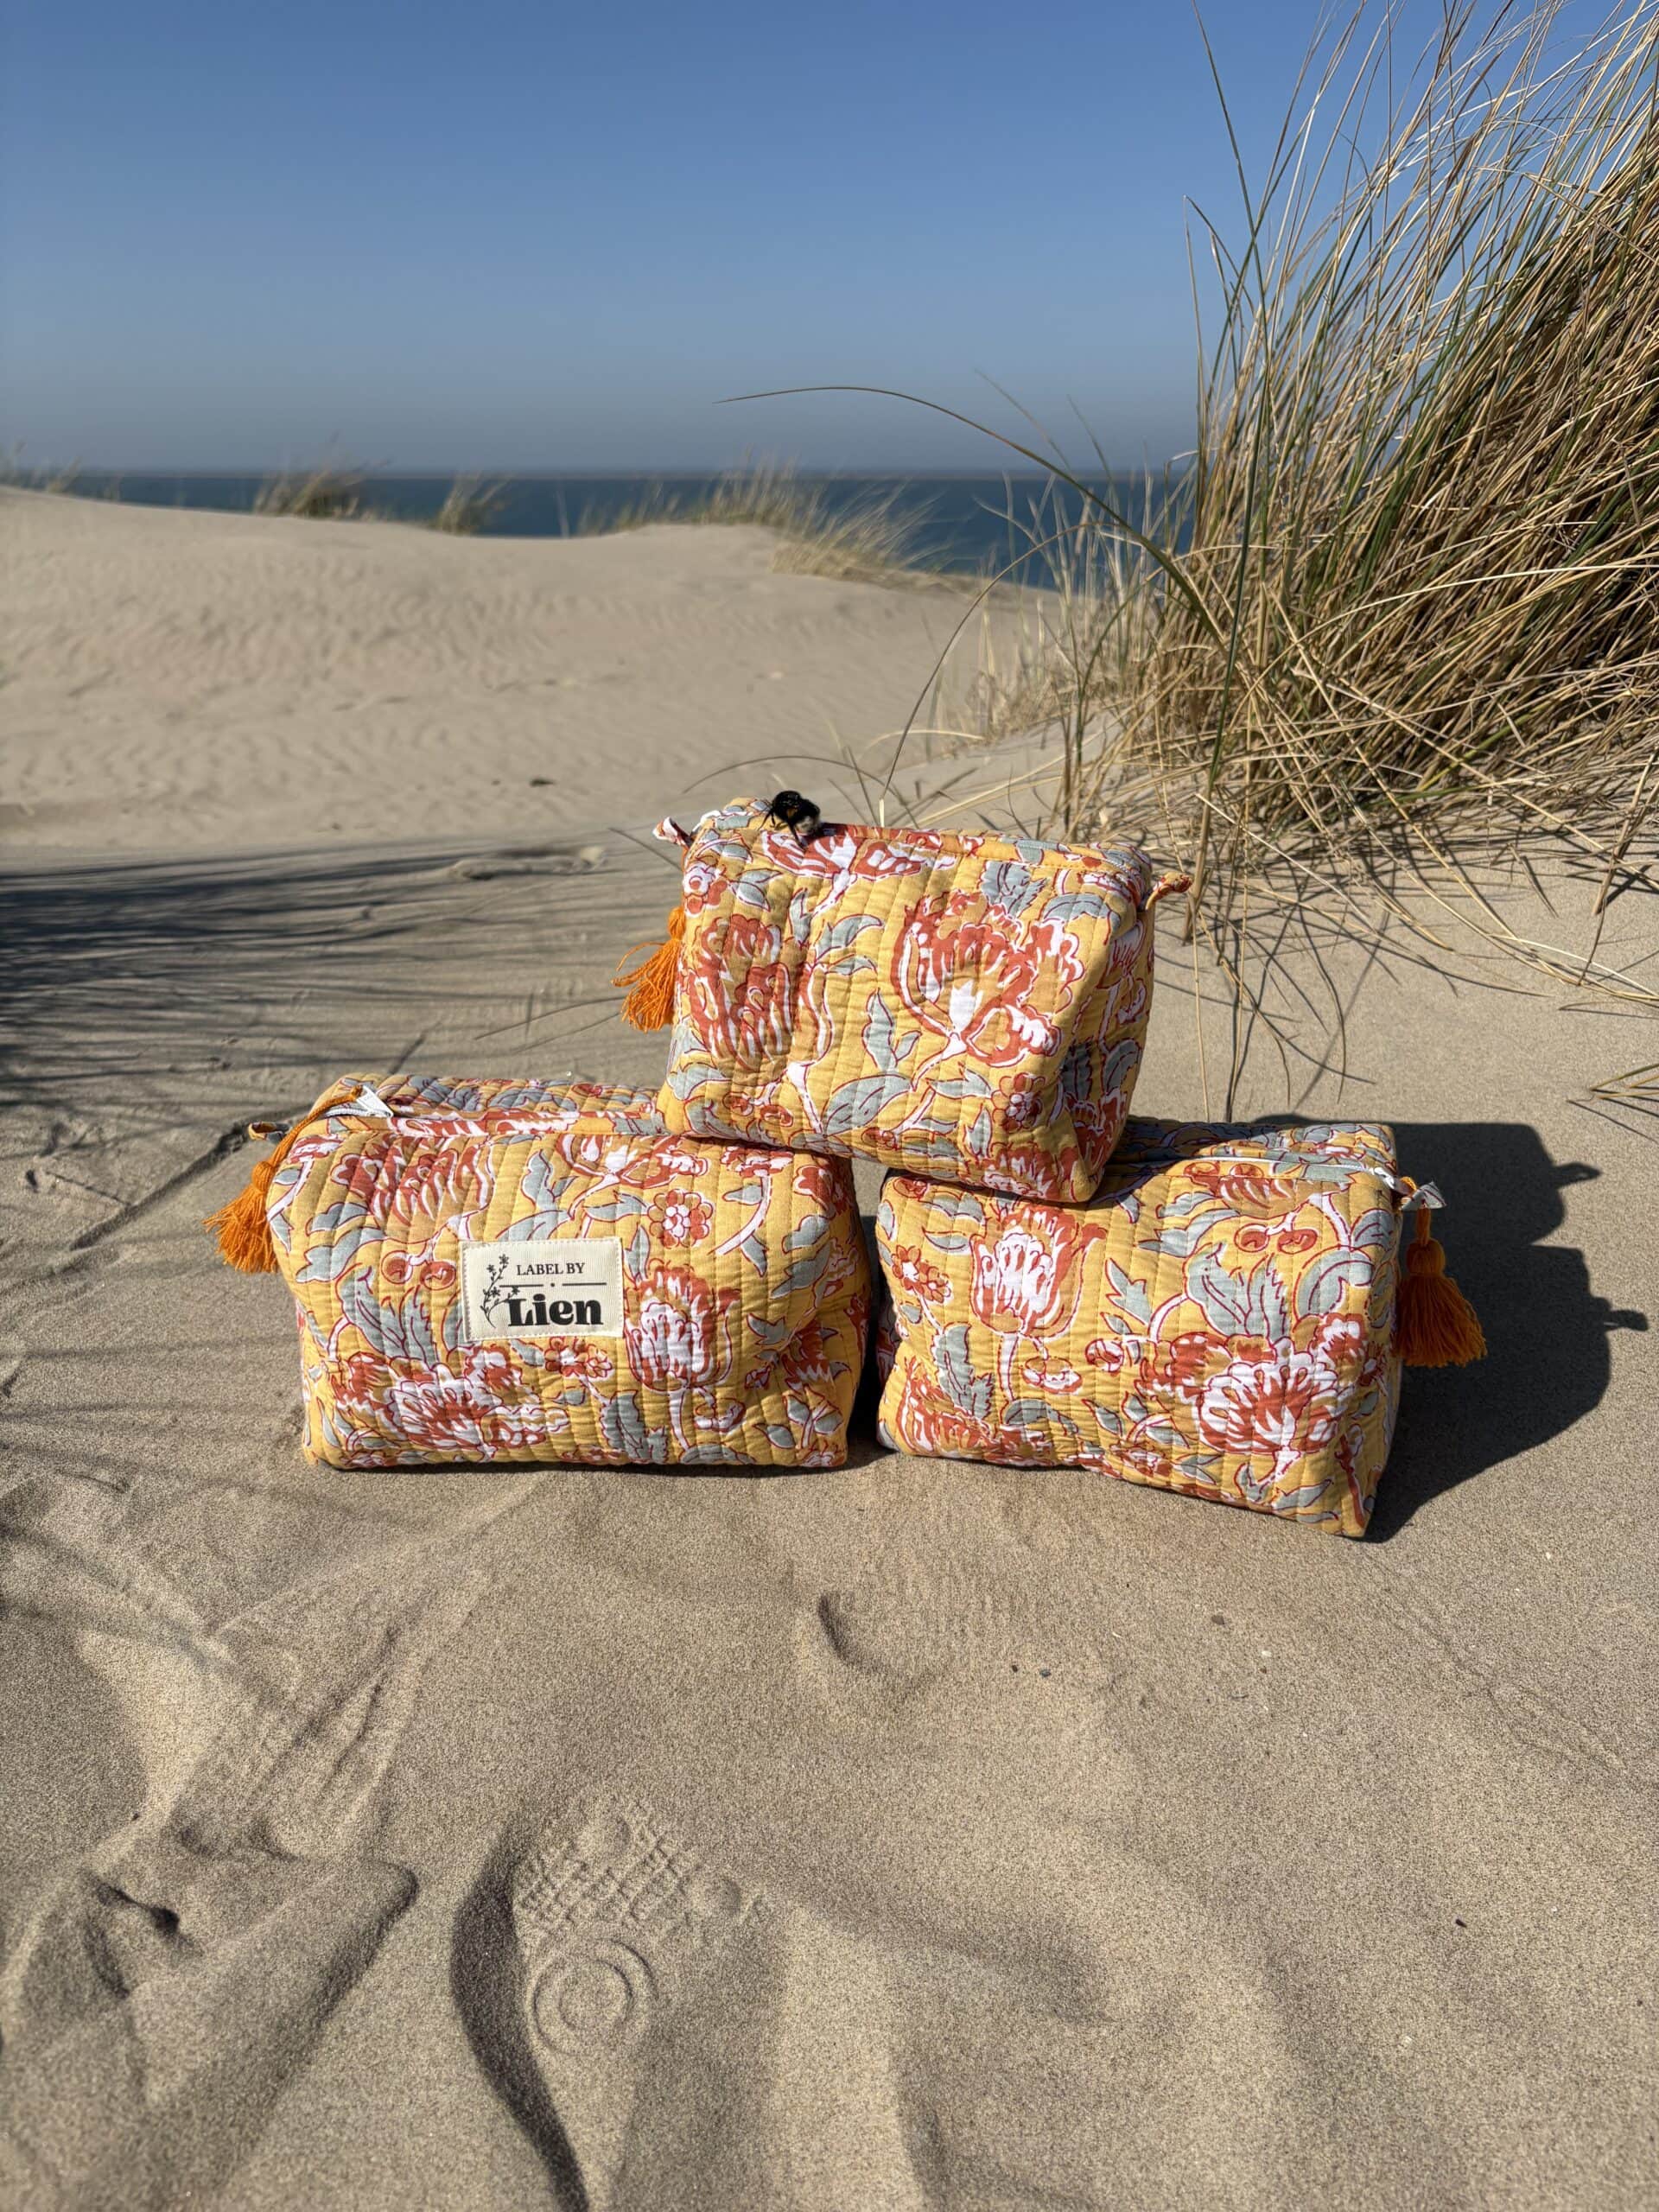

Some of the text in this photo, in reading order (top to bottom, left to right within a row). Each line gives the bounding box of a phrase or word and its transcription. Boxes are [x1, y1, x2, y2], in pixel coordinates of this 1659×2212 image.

[517, 1262, 585, 1275] LABEL BY
[507, 1294, 604, 1326] Lien
